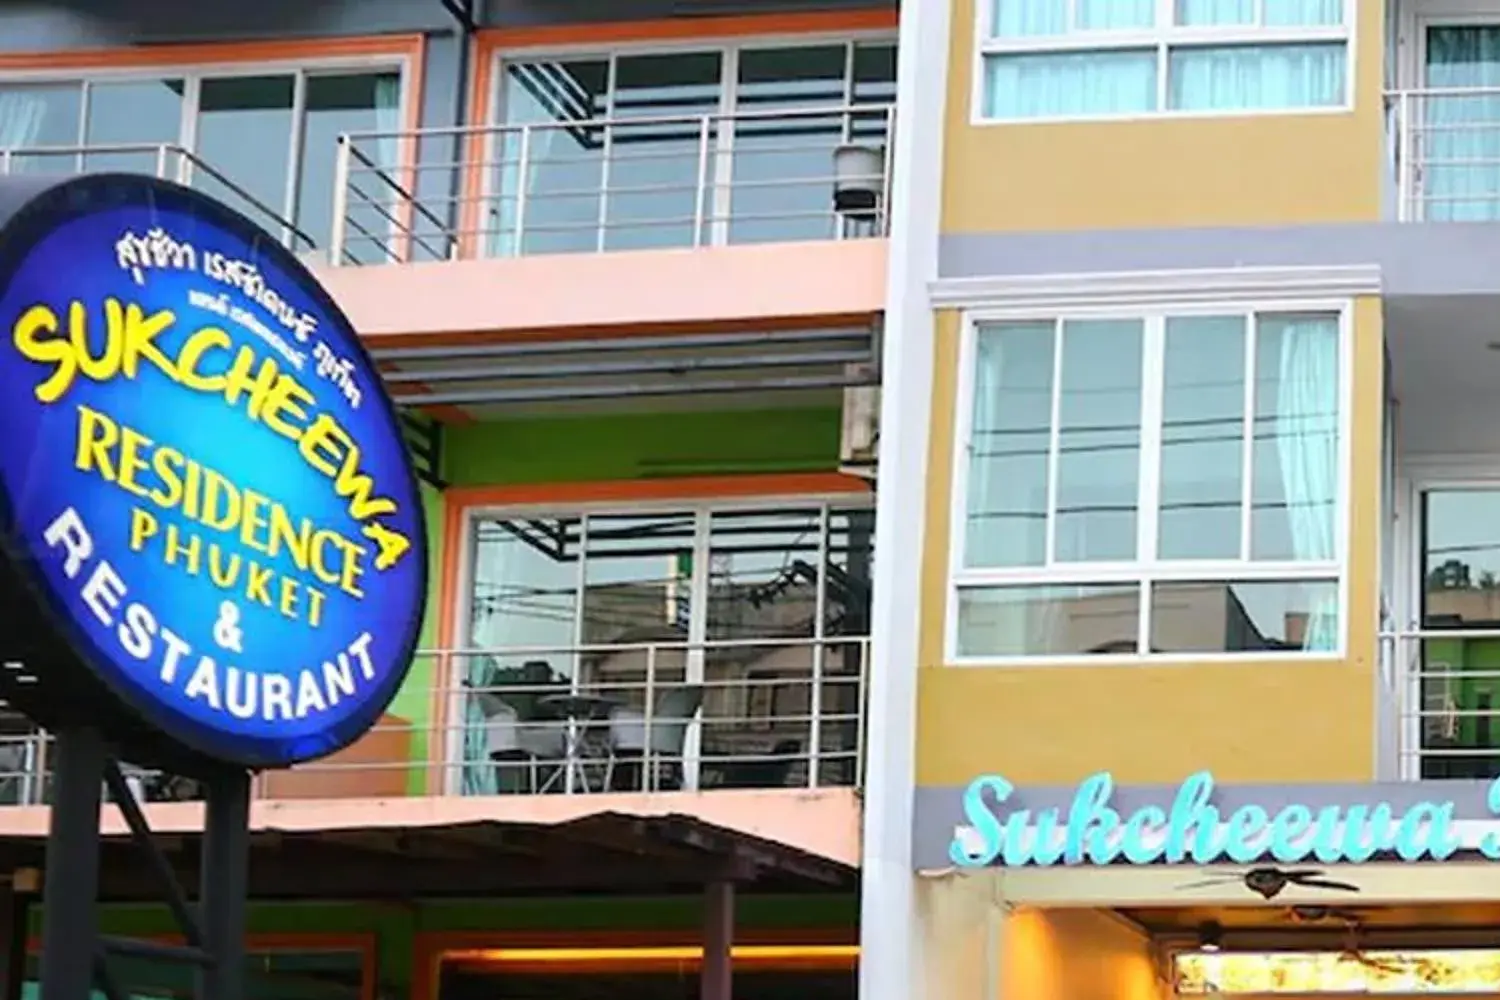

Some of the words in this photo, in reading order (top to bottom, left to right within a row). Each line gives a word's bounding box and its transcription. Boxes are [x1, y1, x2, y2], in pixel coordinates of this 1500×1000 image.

[12, 298, 411, 572] SUKCHEEWA
[75, 405, 367, 598] RESIDENCE
[43, 506, 377, 720] RESTAURANT
[129, 508, 326, 628] PHUKET
[213, 600, 245, 653] &
[949, 770, 1458, 866] Sukcheewa
